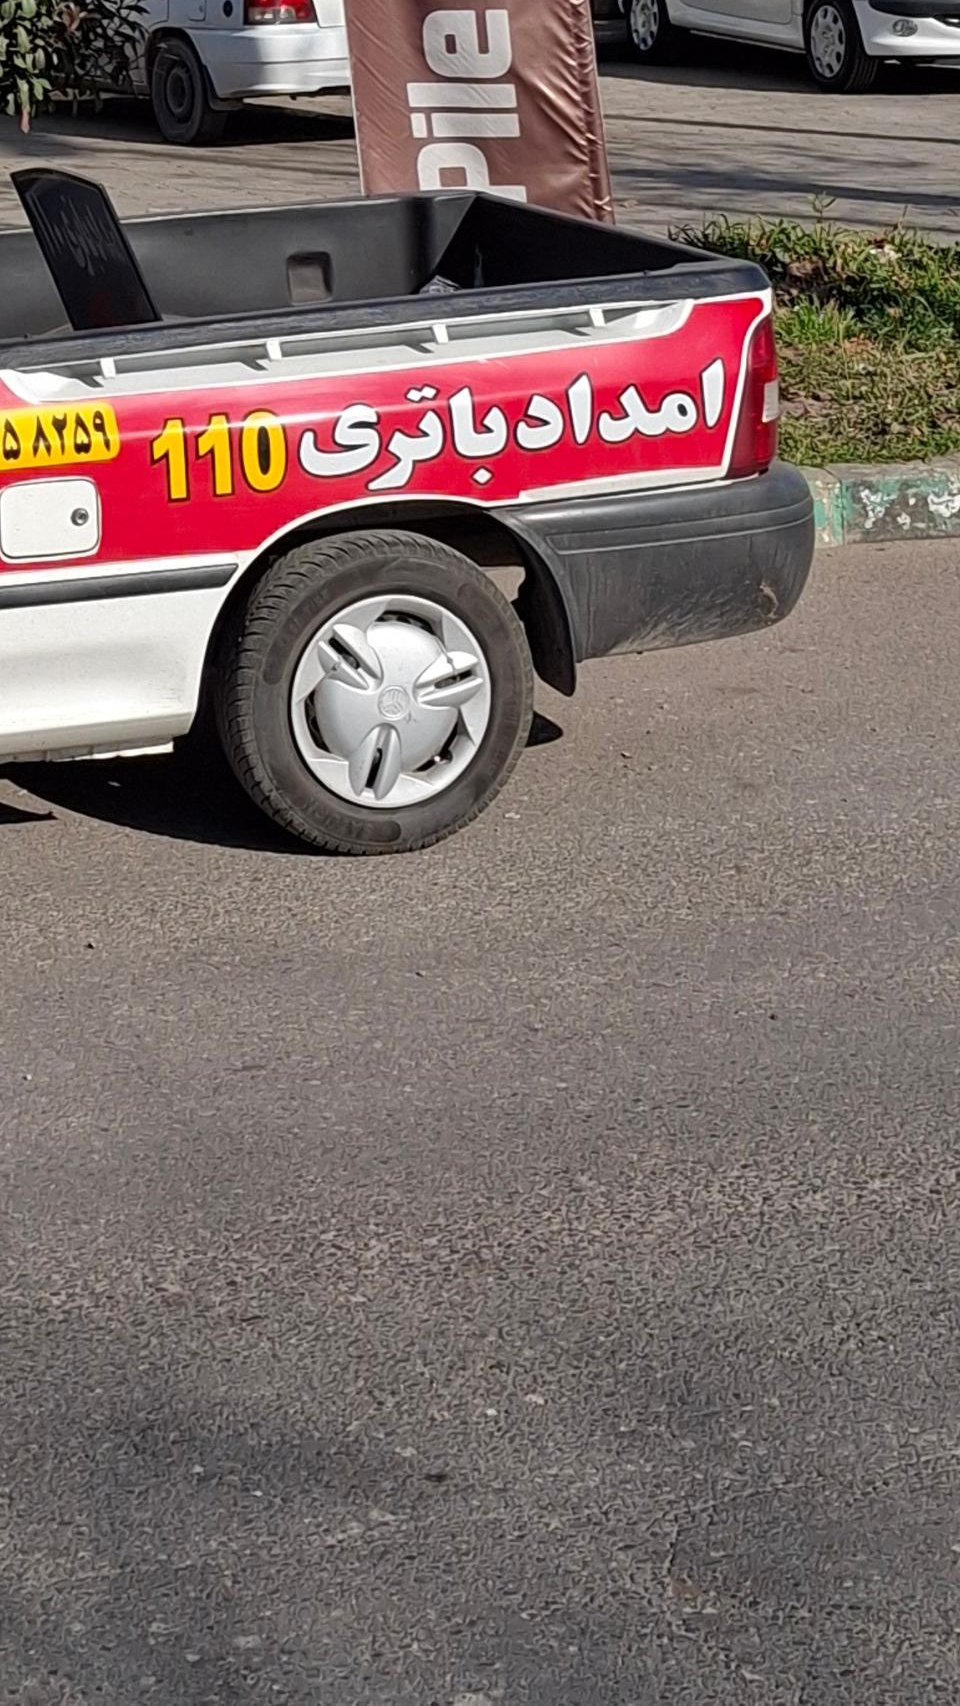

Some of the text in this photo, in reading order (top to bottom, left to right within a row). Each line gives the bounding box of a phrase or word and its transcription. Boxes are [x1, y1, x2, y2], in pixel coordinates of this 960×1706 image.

[149, 356, 727, 501] امداد باتری 110
